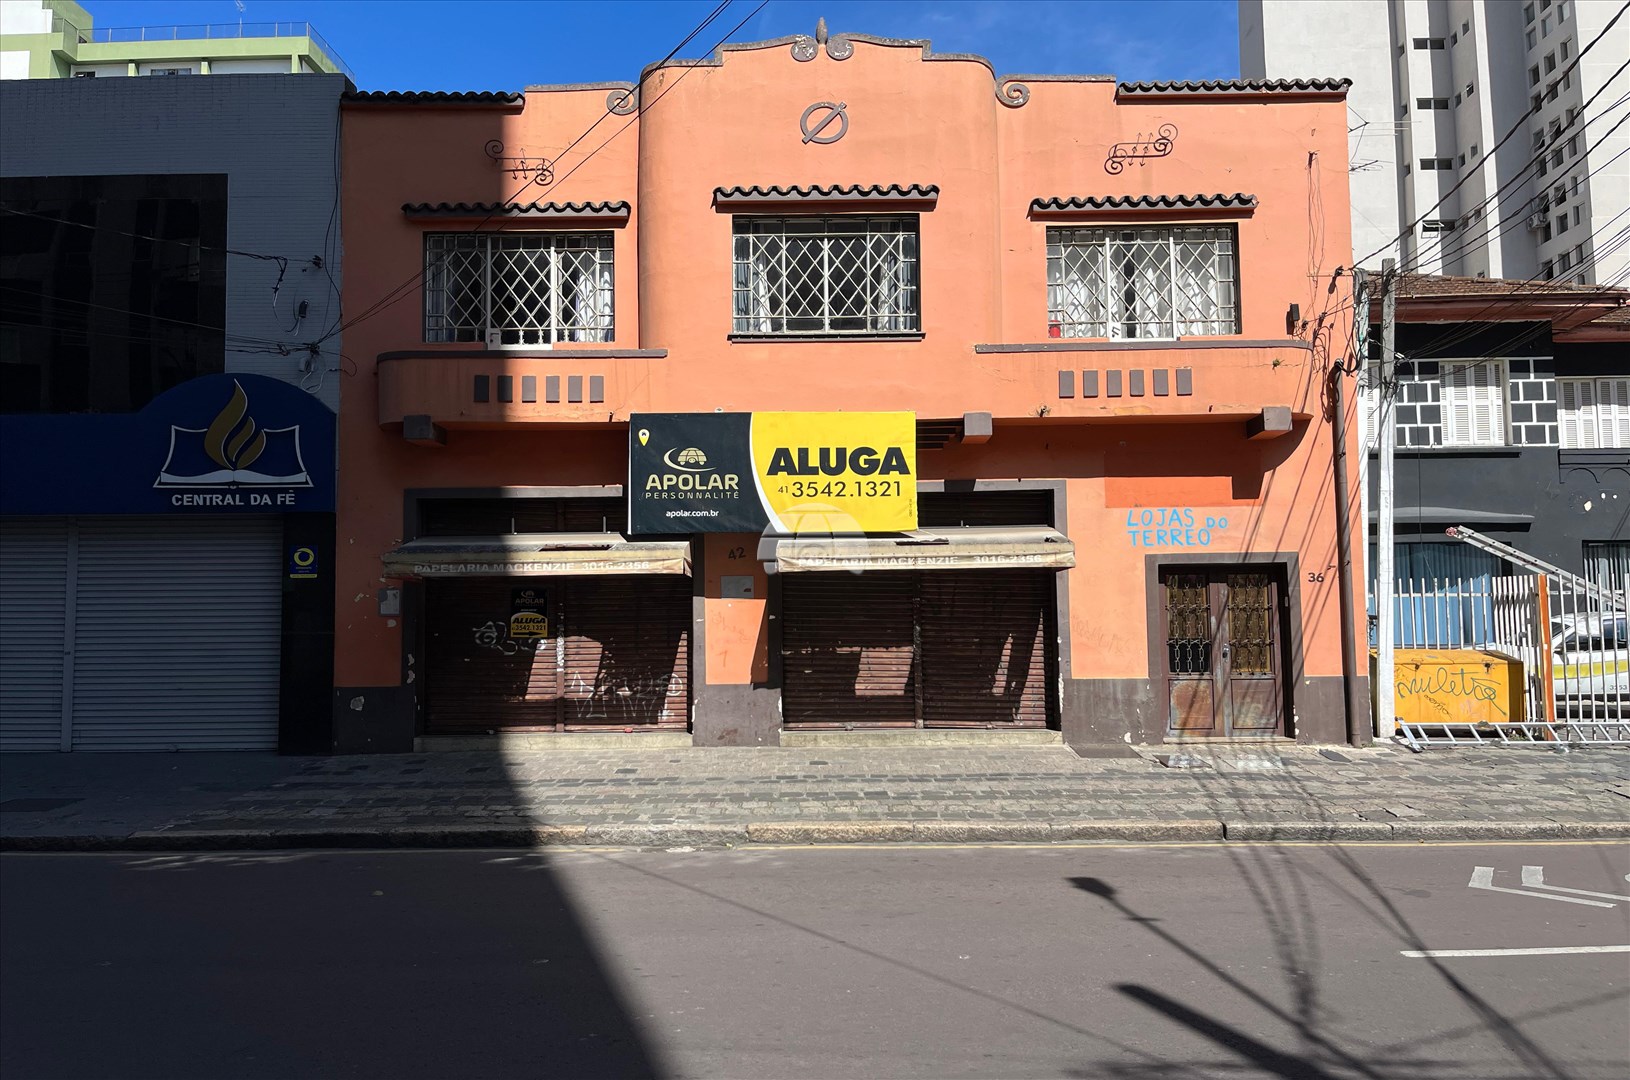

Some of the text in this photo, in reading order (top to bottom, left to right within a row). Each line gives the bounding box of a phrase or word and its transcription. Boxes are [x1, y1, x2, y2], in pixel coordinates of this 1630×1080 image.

[766, 446, 911, 476] ALUGA
[645, 473, 739, 490] APOLAR
[778, 480, 902, 498] 41 3542.1321
[171, 489, 296, 506] CENTRAL DA FÉ
[645, 490, 740, 499] PERSONNALITÉ
[665, 509, 720, 518] apolar.com.br
[1127, 509, 1194, 527] LOJAS
[1127, 528, 1212, 547] TERREO
[728, 547, 746, 561] 42
[877, 556, 958, 566] MACKENZIE
[414, 562, 490, 574] PAPELARIA
[492, 561, 575, 573] MACKENZIE
[1308, 573, 1324, 583] 36
